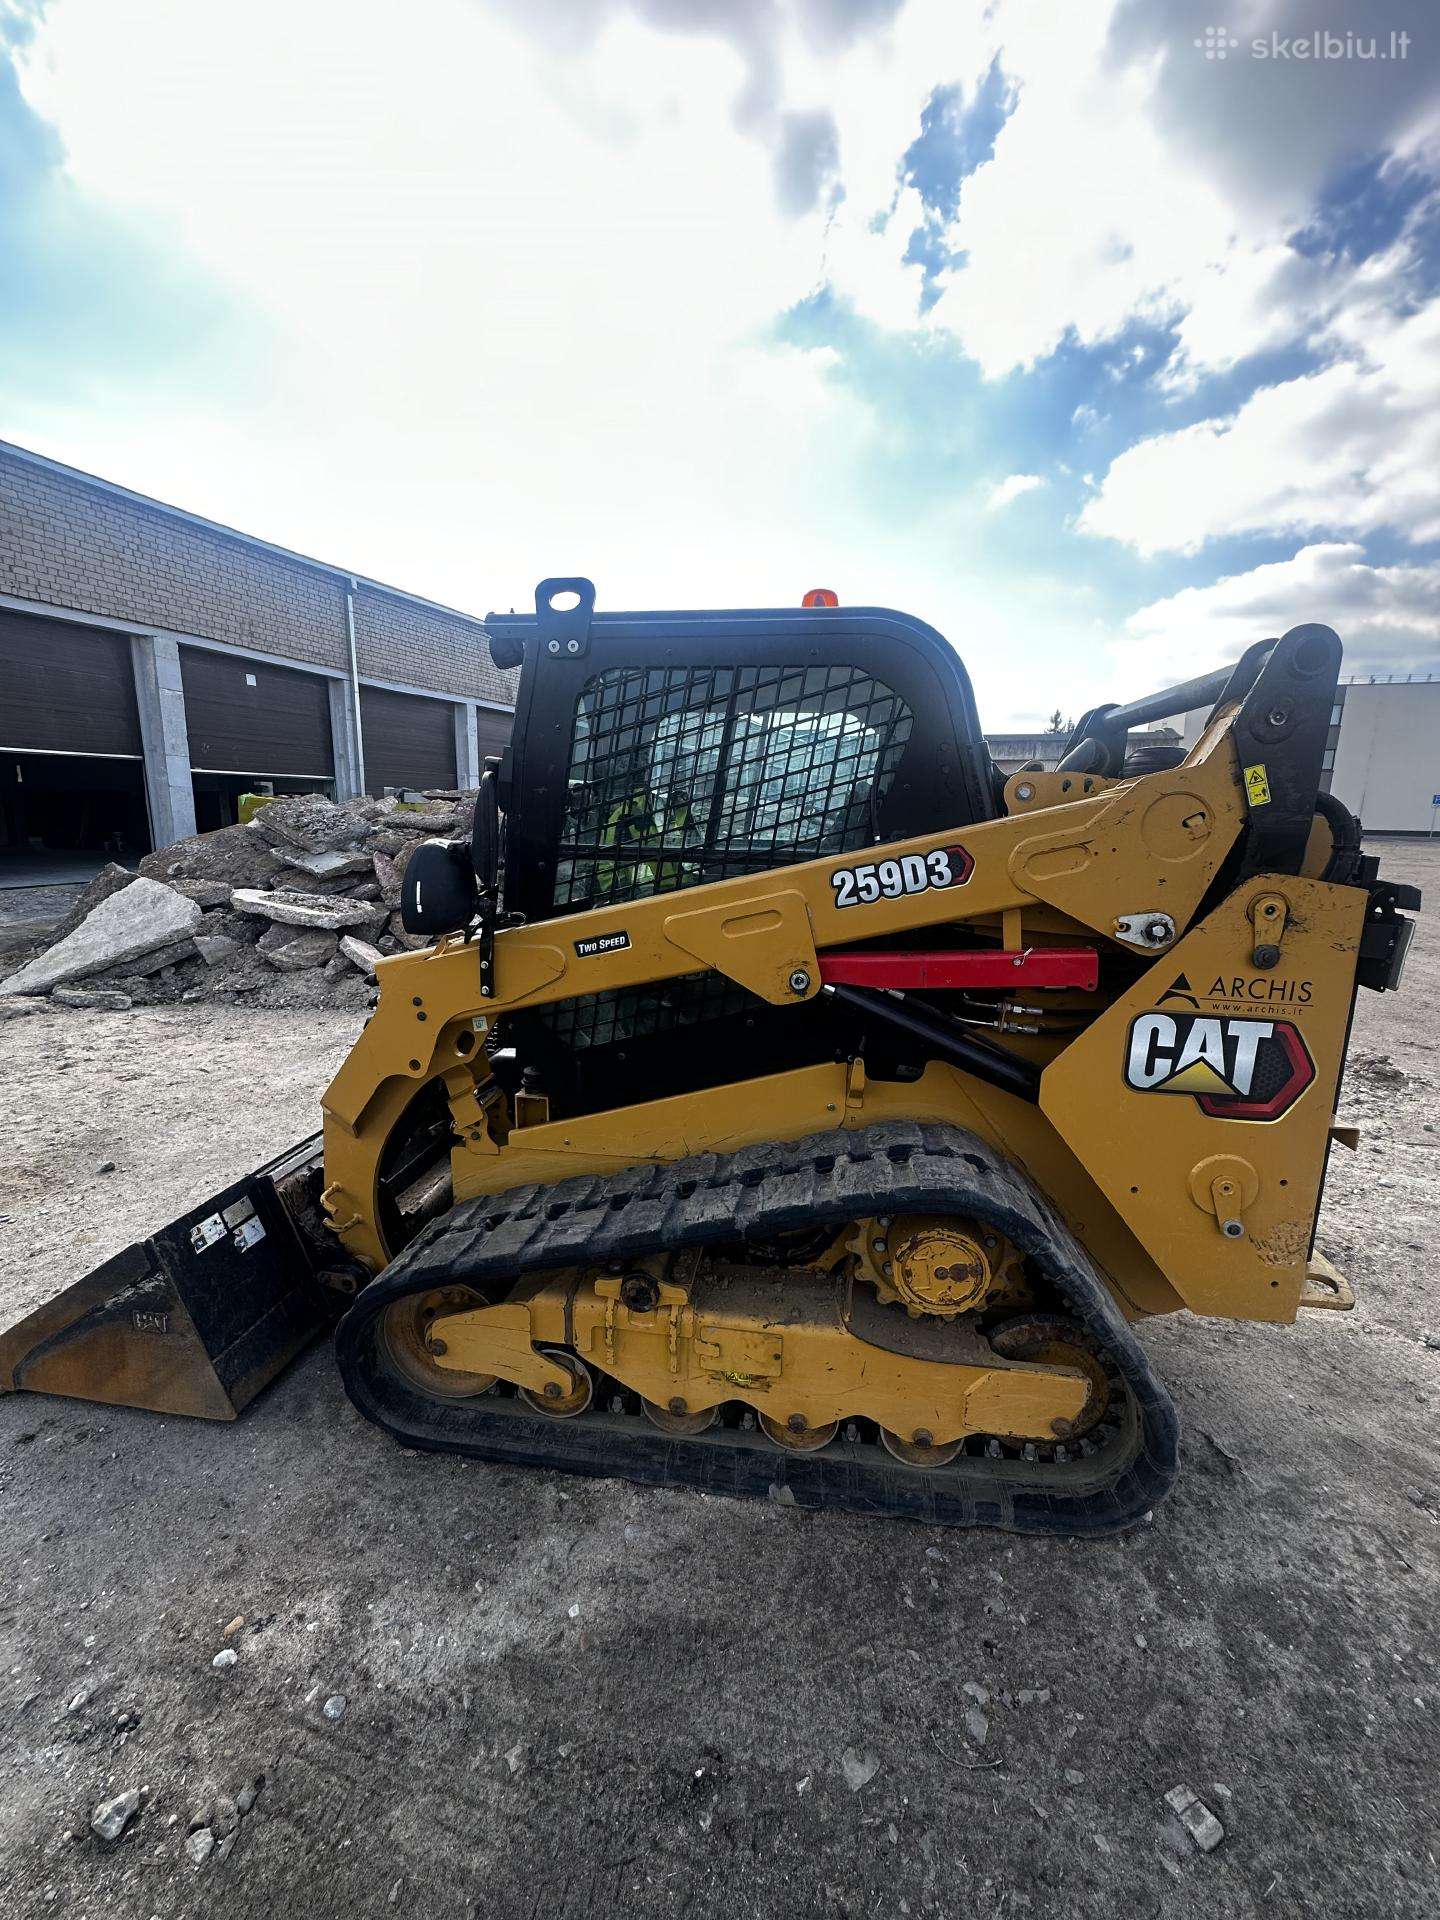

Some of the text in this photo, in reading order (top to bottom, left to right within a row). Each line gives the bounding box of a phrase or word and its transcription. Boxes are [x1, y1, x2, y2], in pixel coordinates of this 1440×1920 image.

[832, 850, 953, 907] 259D3
[1208, 975, 1314, 1003] ARCHIS
[1127, 1013, 1274, 1097] CAT
